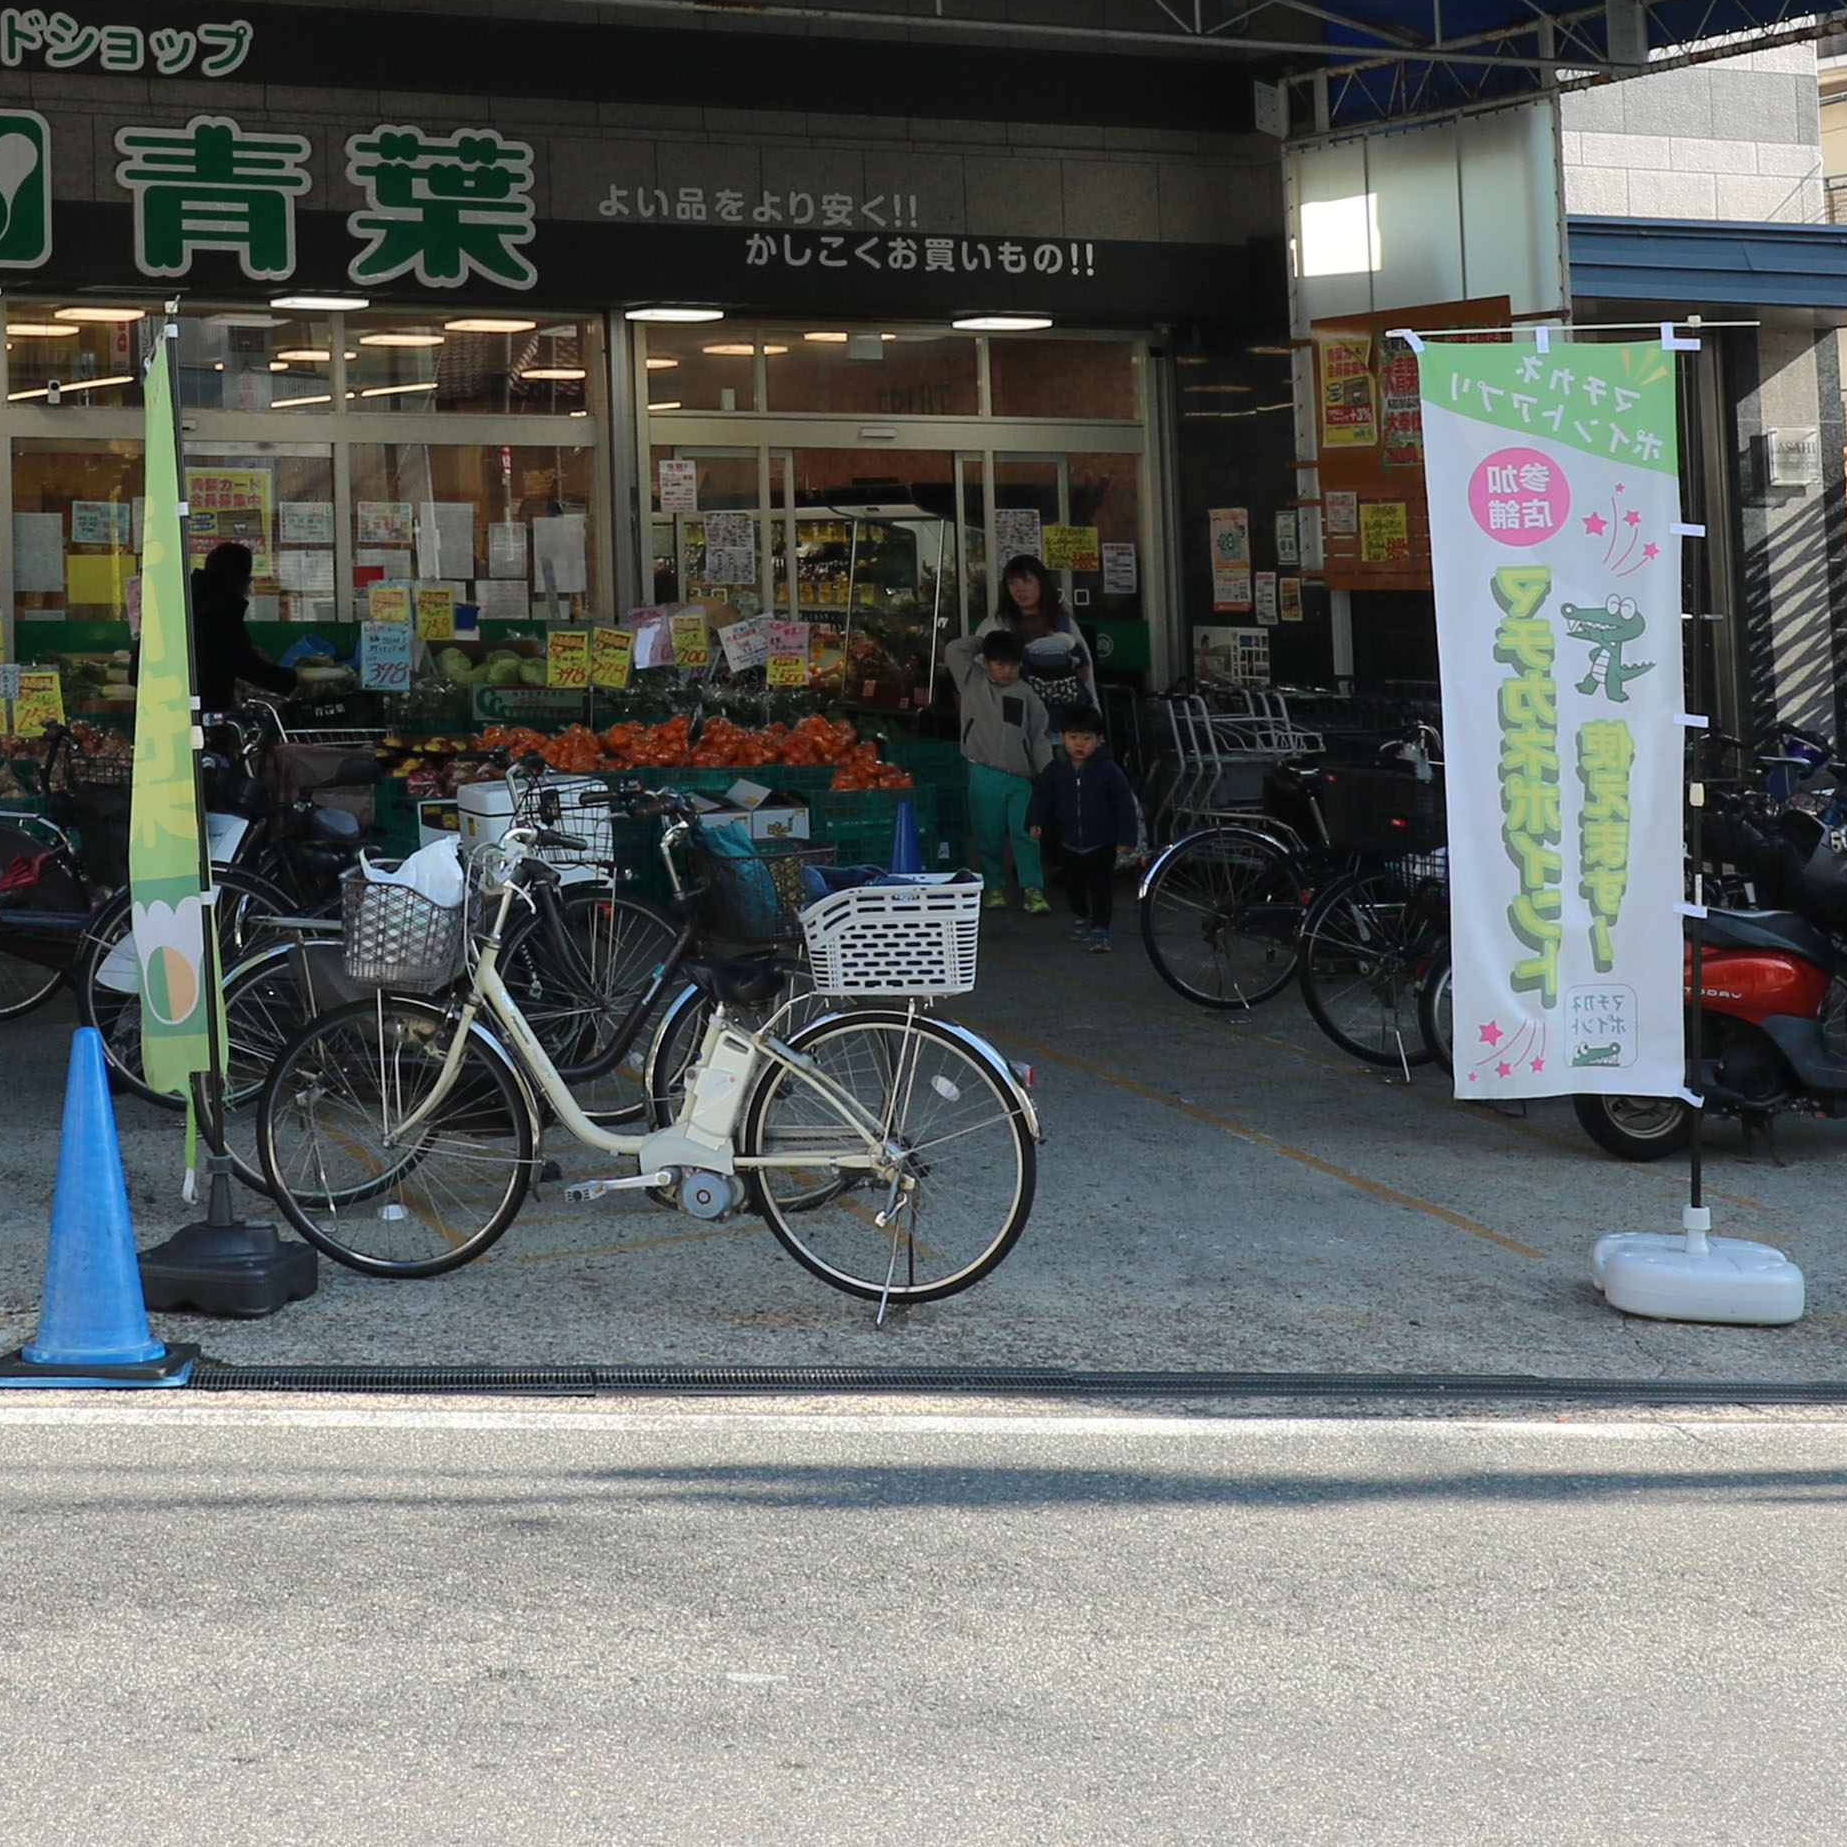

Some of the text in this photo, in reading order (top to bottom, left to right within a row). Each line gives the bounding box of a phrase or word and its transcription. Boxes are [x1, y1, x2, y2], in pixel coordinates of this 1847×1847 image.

[114, 114, 539, 291] 青葉
[598, 184, 918, 228] よい品をより安く!!
[746, 233, 1095, 277] かしこくお買いもの!!
[368, 661, 408, 684] 398
